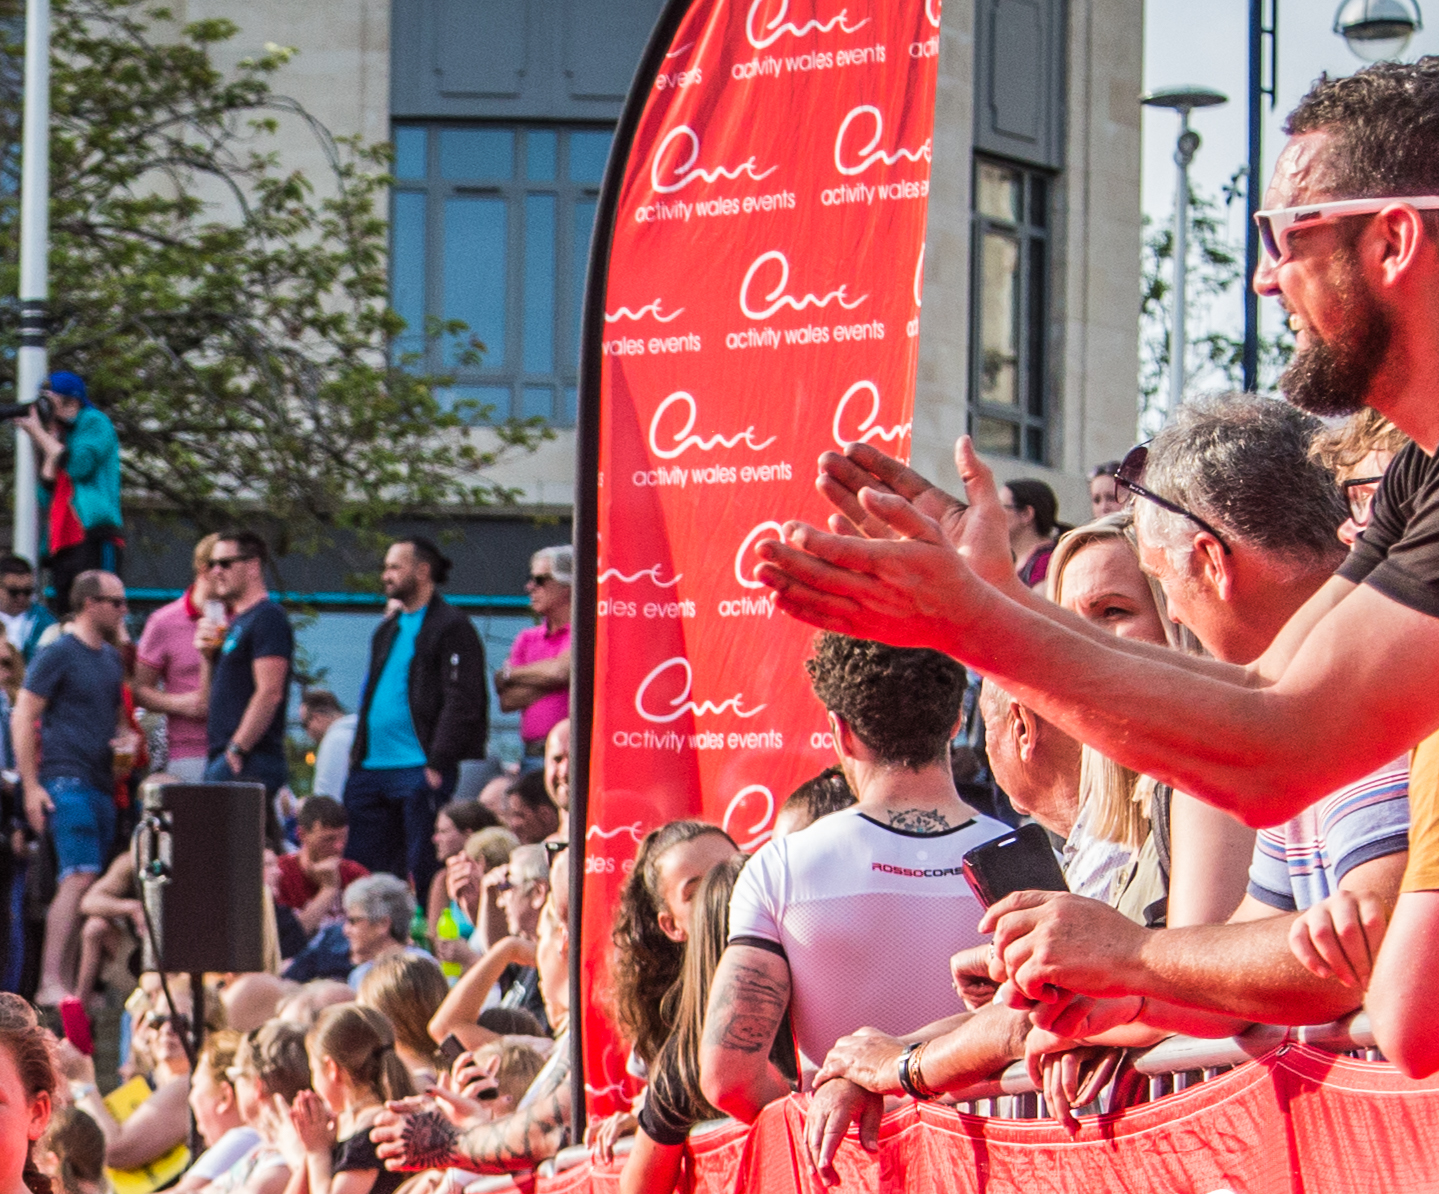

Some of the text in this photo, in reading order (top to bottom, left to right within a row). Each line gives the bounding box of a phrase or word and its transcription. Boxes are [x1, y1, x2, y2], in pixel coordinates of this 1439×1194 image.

[786, 49, 833, 72] wales
[836, 44, 886, 67] events
[821, 181, 876, 206] activity
[877, 178, 919, 200] wales
[635, 189, 796, 223] activity wales events
[648, 332, 701, 355] events
[726, 319, 885, 350] activity wales events
[632, 461, 792, 488] activity wales events
[643, 596, 696, 619] events
[613, 730, 685, 754] activity
[727, 728, 783, 749] events
